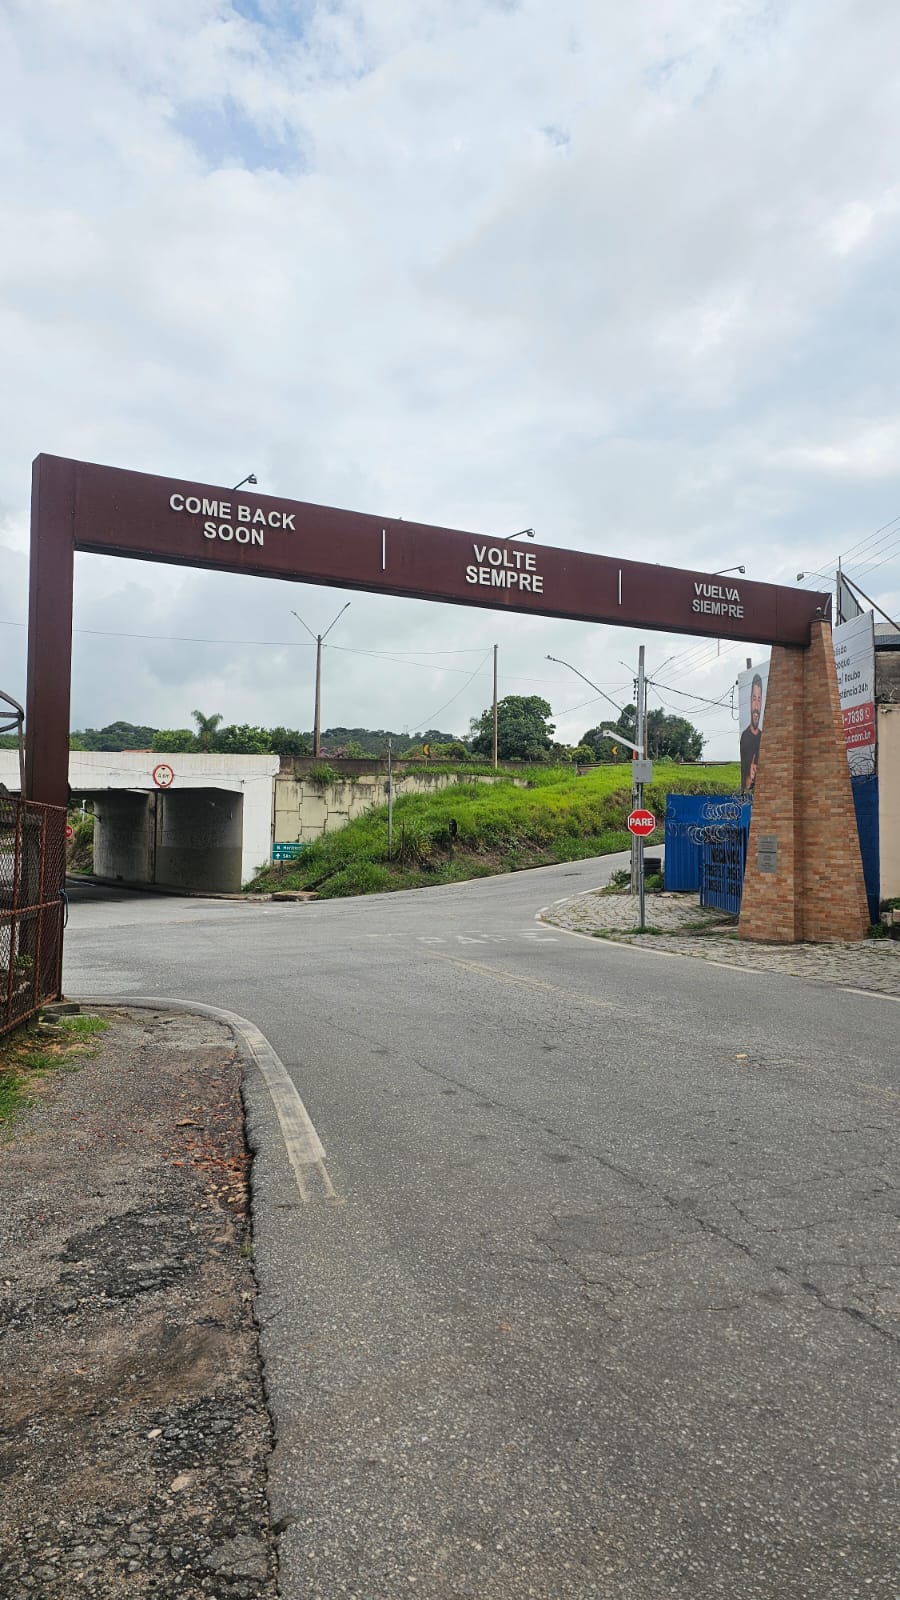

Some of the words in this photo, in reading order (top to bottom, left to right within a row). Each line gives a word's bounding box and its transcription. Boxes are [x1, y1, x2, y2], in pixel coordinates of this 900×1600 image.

[170, 493, 232, 520] COME
[238, 504, 297, 531] BACK
[203, 521, 264, 546] SOON
[473, 544, 537, 571] VOLTE
[465, 565, 544, 594] SEMPRE
[694, 582, 741, 602] VUELVA
[692, 599, 744, 619] SIEMPRE
[629, 817, 654, 827] PARE
